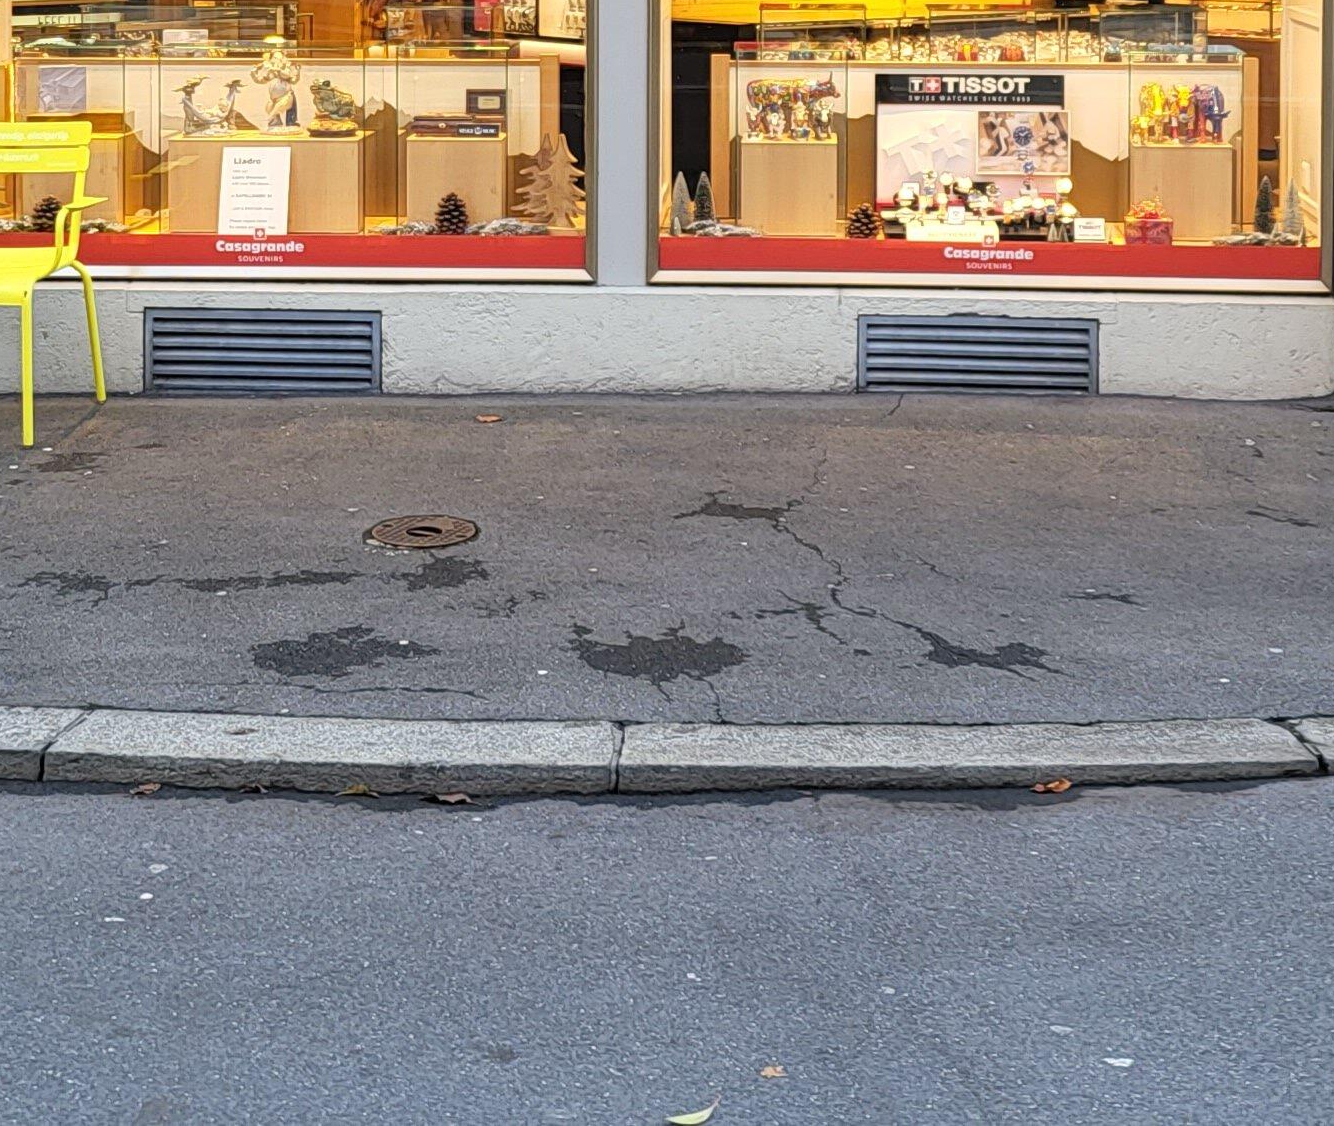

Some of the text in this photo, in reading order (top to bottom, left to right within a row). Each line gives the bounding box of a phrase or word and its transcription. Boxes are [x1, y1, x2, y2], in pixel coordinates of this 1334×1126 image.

[942, 77, 1030, 94] TISSOT
[215, 240, 304, 253] Casagrande
[237, 255, 283, 263] SOUVENIRS
[943, 246, 1034, 261] Casagrande
[966, 262, 1013, 270] SOUVENIRS
